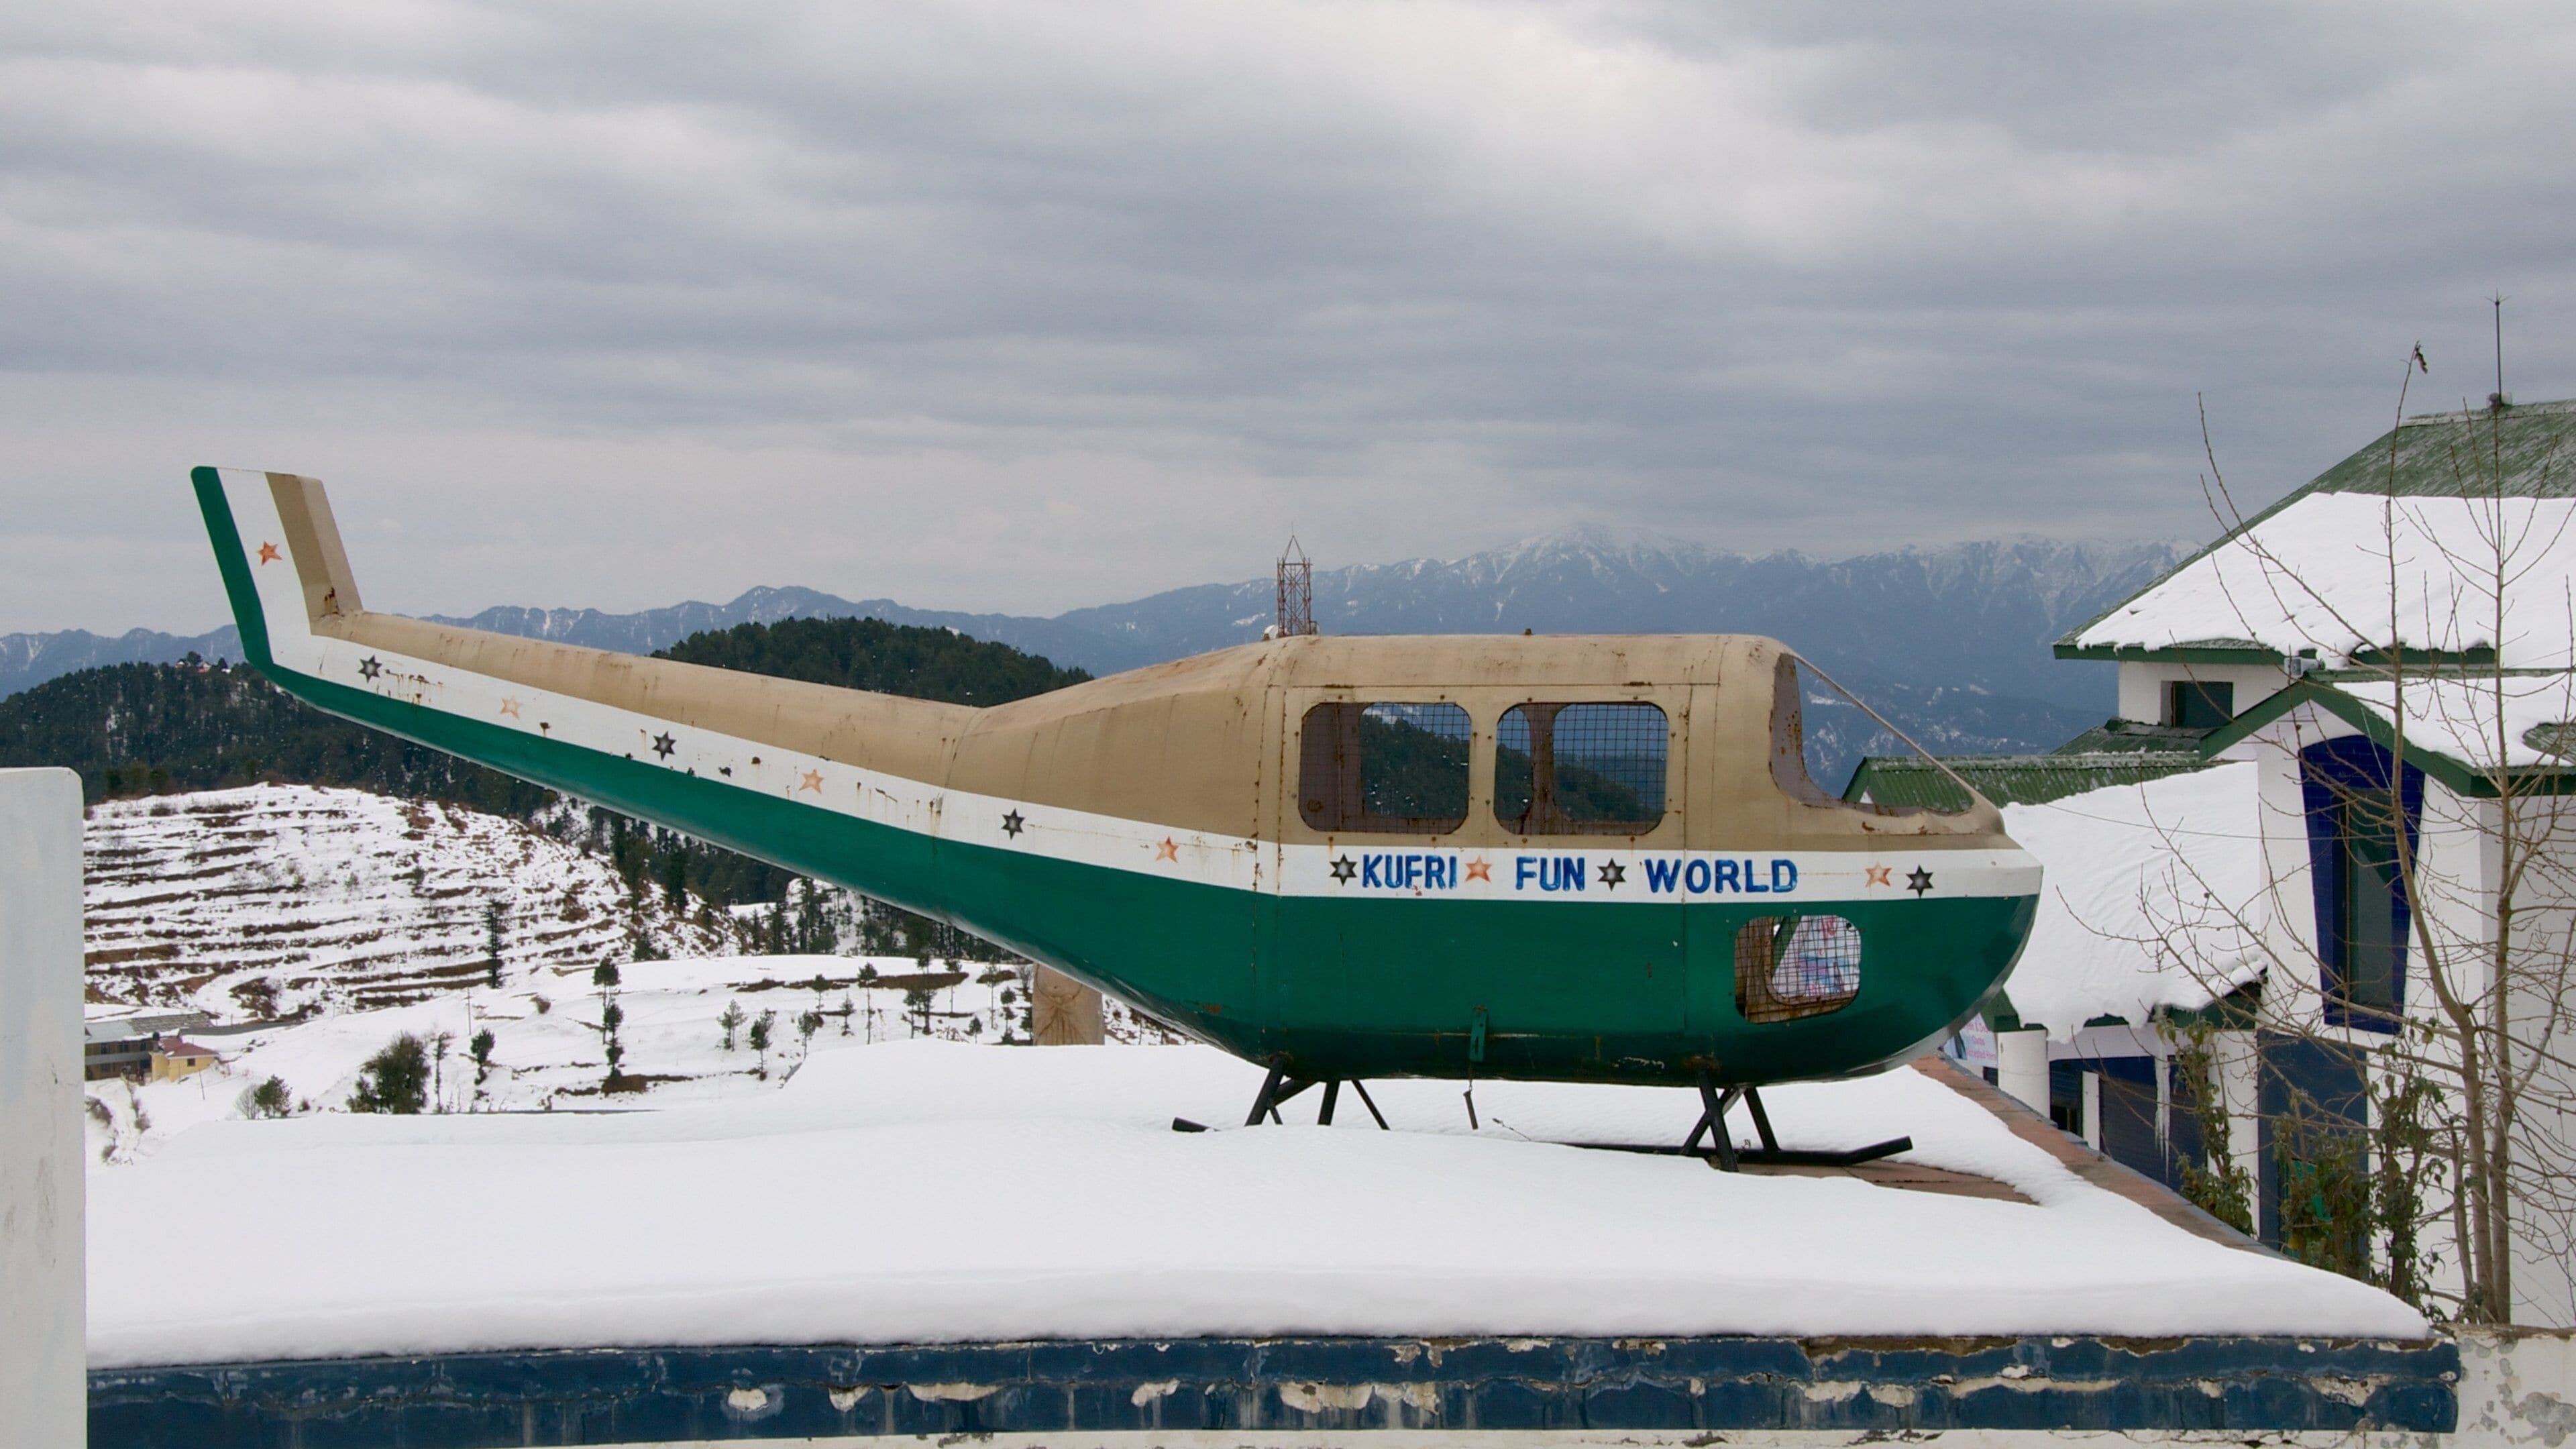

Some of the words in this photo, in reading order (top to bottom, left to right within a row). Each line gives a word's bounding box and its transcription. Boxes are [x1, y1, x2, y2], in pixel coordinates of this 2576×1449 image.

[1362, 854, 1458, 889] KUFRI
[1515, 855, 1586, 892] FUN
[1645, 858, 1799, 894] WORLD
